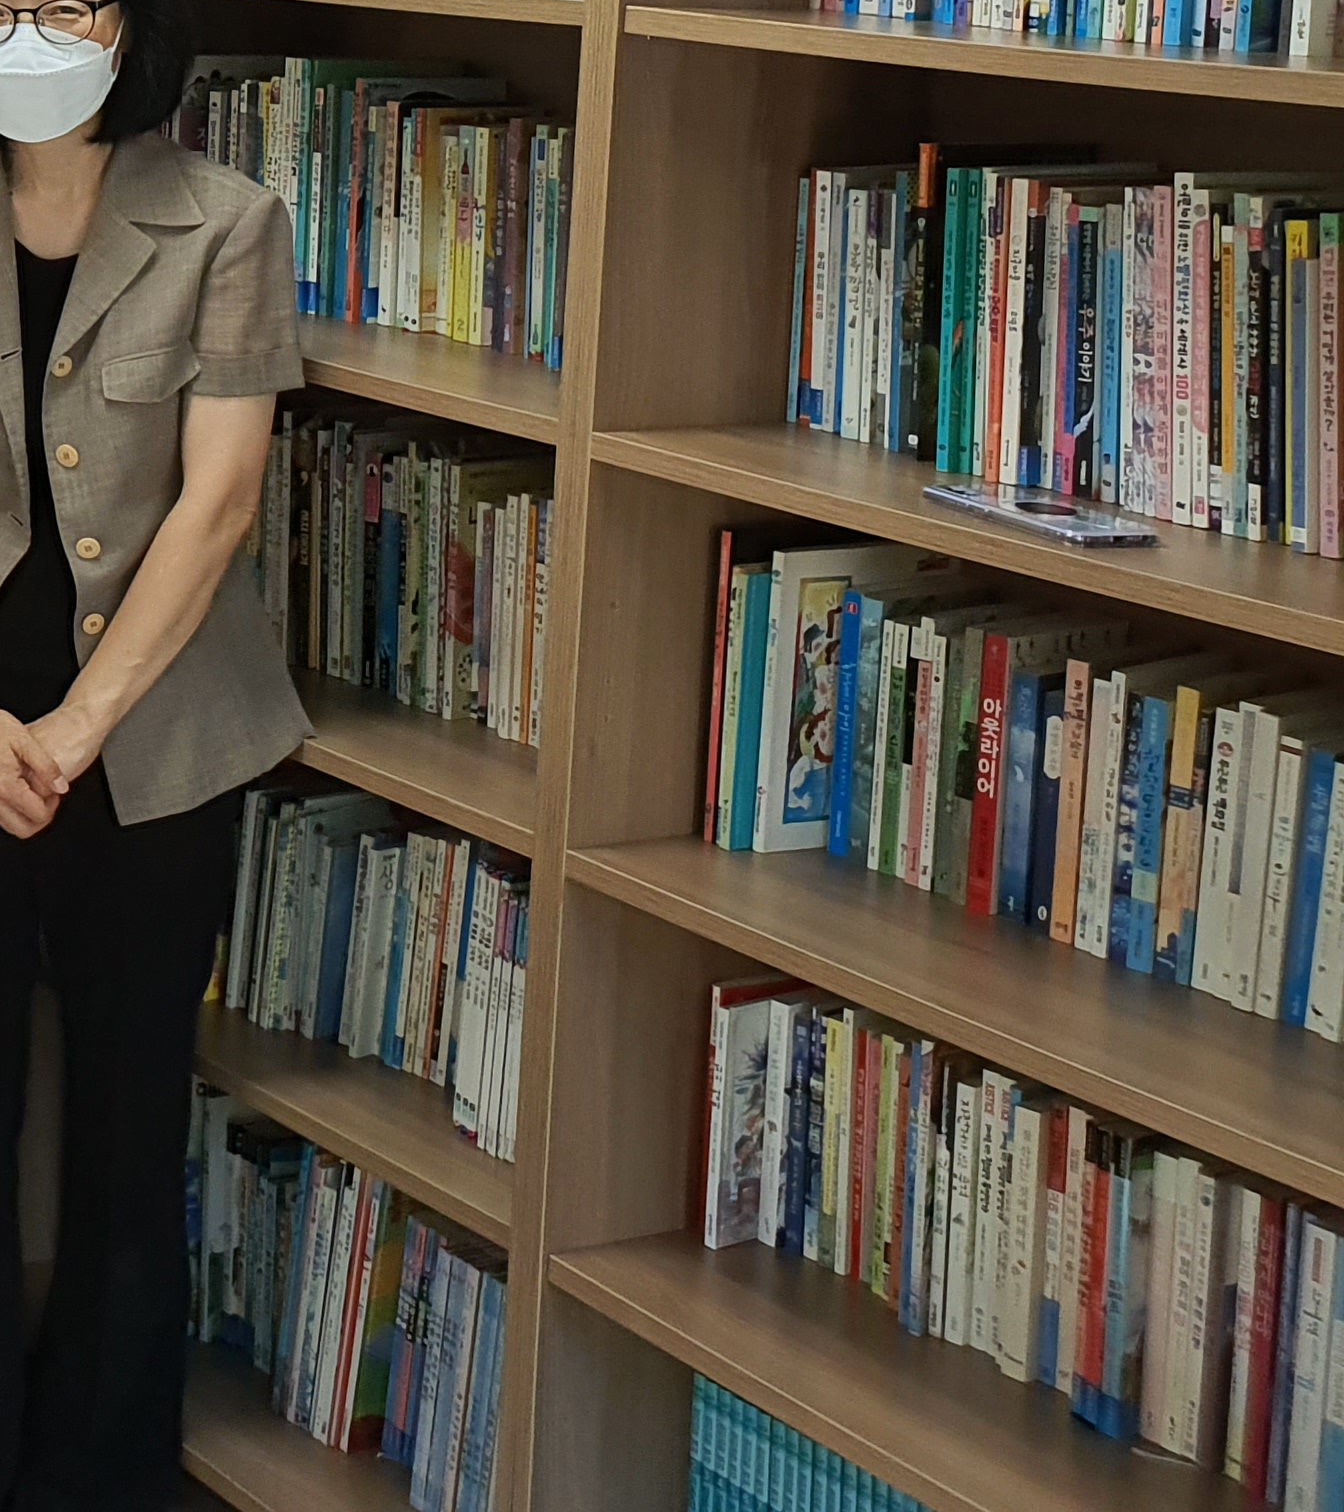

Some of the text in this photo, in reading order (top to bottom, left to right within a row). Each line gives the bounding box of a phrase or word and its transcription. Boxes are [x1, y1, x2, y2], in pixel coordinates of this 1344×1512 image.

[1179, 232, 1191, 252] 위한
[1077, 304, 1096, 383] 우주 이야기
[1175, 328, 1190, 369] 세계사
[1175, 373, 1189, 400] 100
[976, 697, 1002, 799] 아웃라이어
